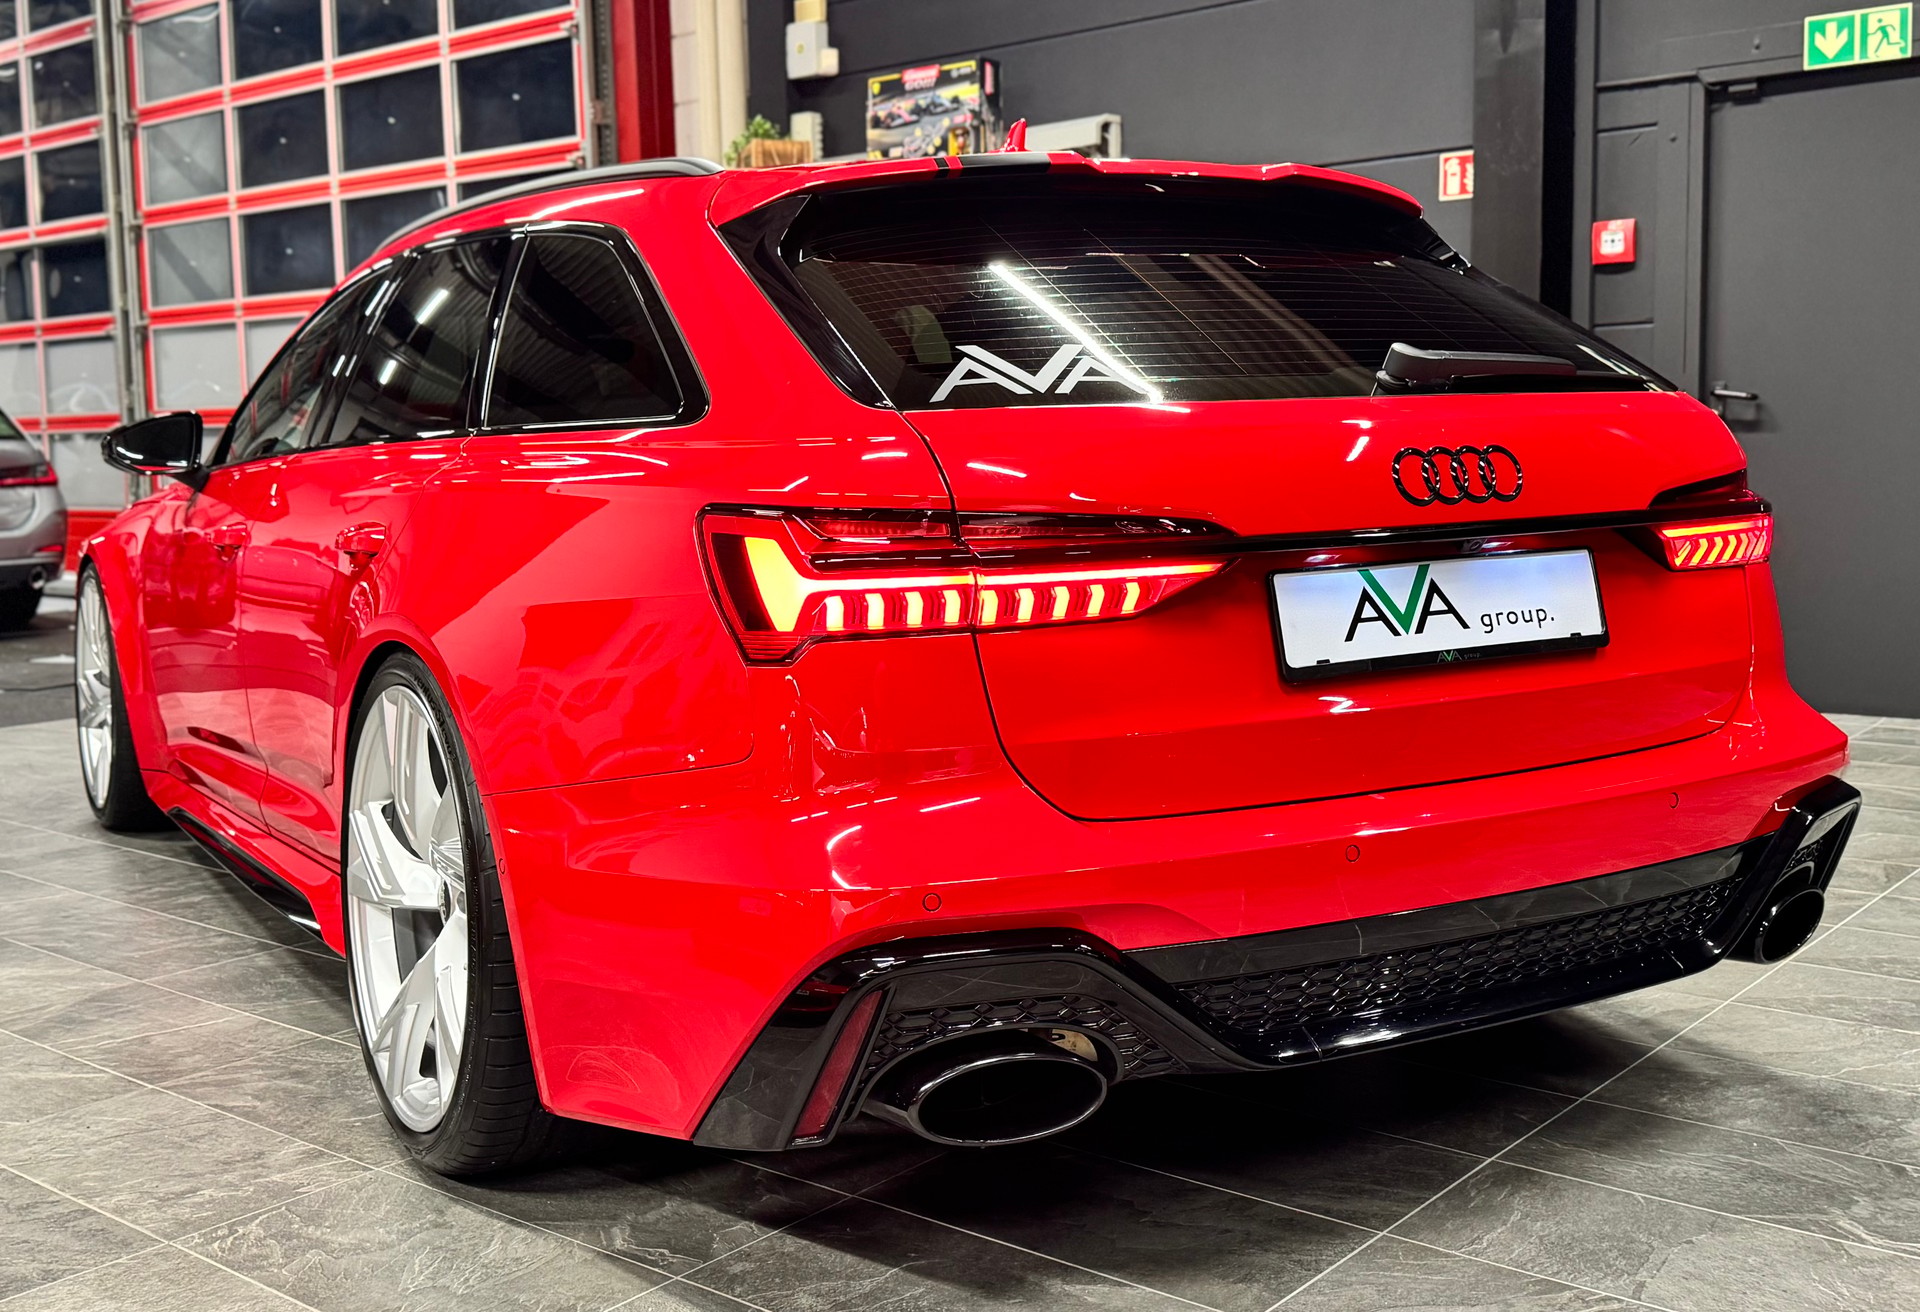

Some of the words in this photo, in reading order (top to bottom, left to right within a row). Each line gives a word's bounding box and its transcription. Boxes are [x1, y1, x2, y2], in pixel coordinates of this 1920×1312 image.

[929, 344, 1149, 403] AVA
[1344, 563, 1471, 643] AVA
[1480, 605, 1556, 634] group.
[1437, 649, 1462, 663] AVA
